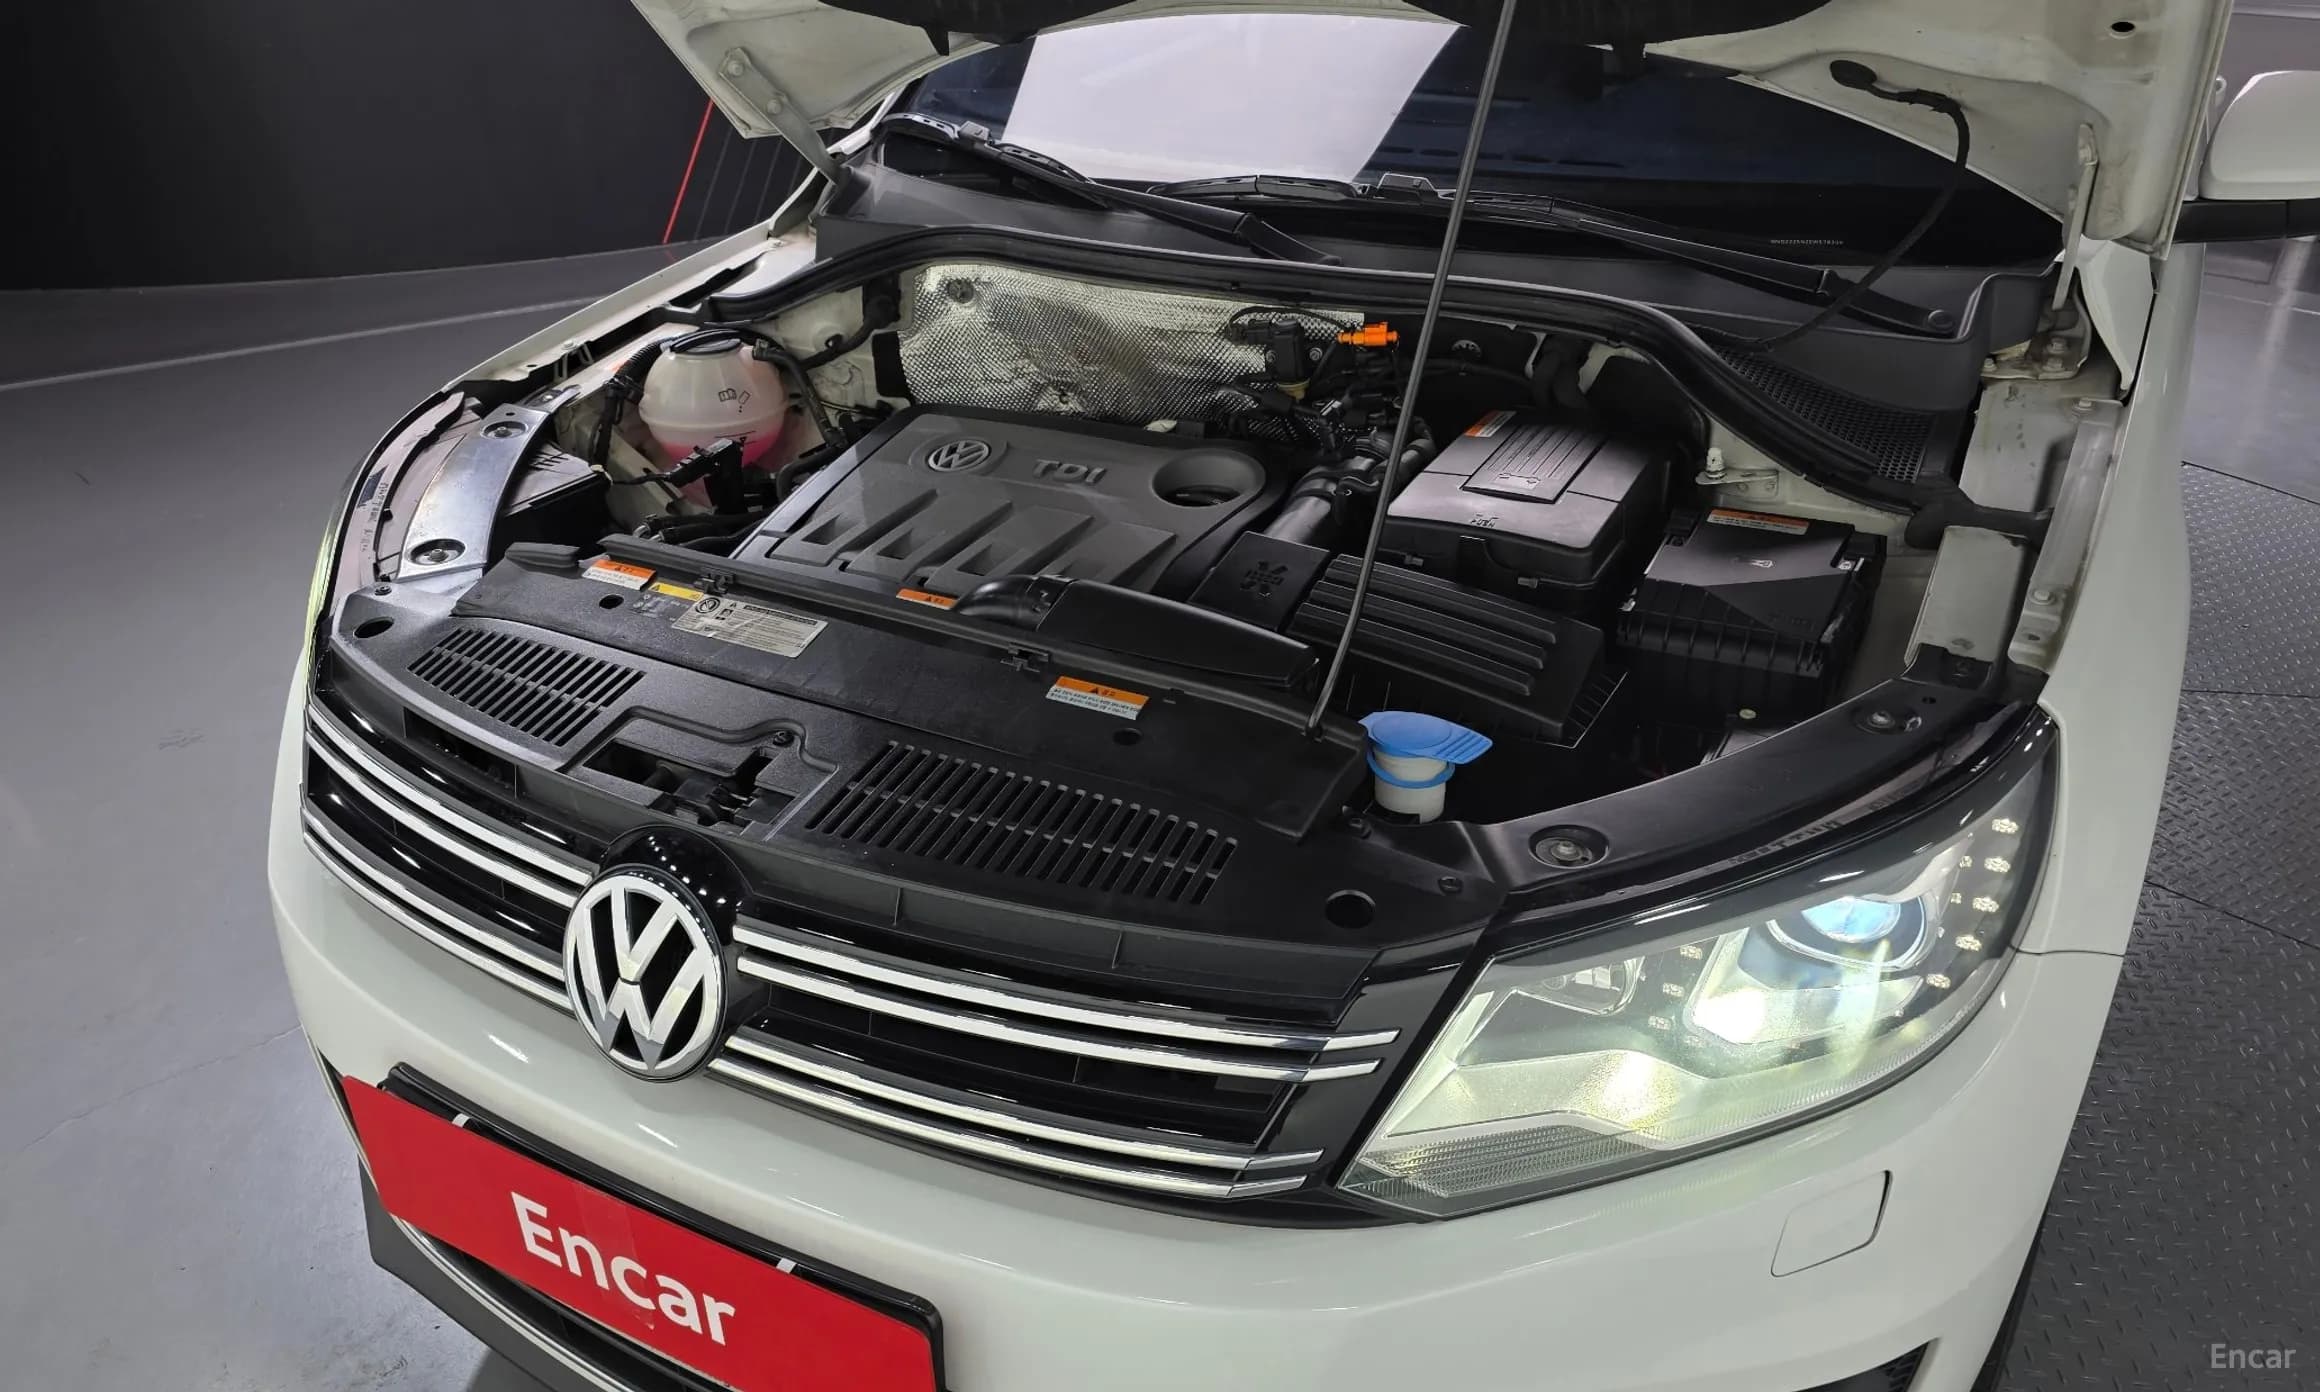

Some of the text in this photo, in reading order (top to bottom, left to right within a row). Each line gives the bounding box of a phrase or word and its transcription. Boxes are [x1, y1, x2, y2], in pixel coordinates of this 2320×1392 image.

[1032, 458, 1106, 484] TDI
[566, 873, 722, 1077] VW
[511, 1191, 736, 1346] Encar
